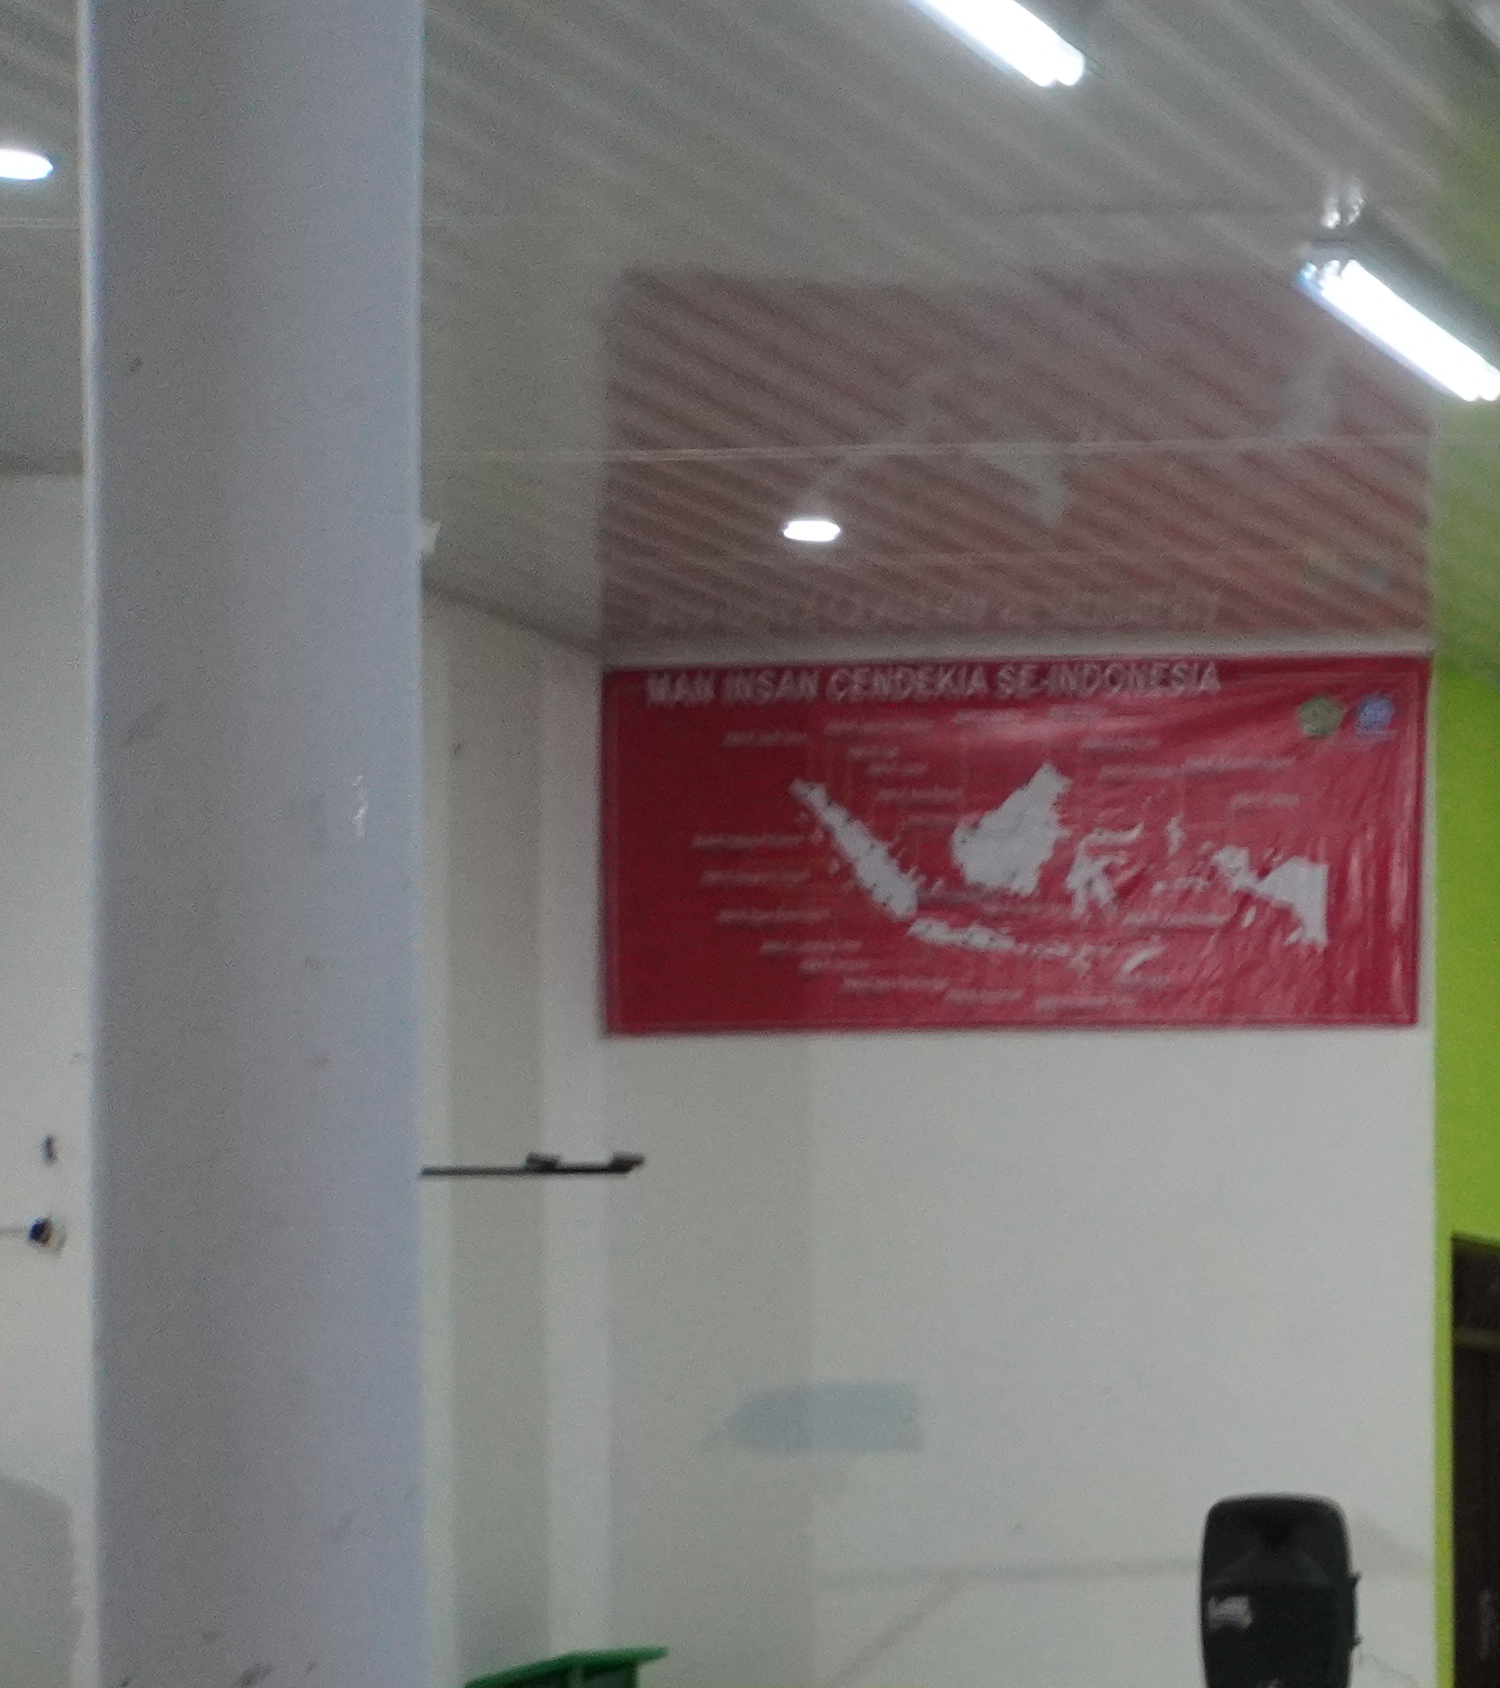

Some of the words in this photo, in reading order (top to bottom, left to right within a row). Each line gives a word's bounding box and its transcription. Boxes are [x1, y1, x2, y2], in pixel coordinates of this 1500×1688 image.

[645, 670, 716, 708] MAN
[720, 668, 820, 706] INSAN
[825, 664, 990, 704] CENDEKIA
